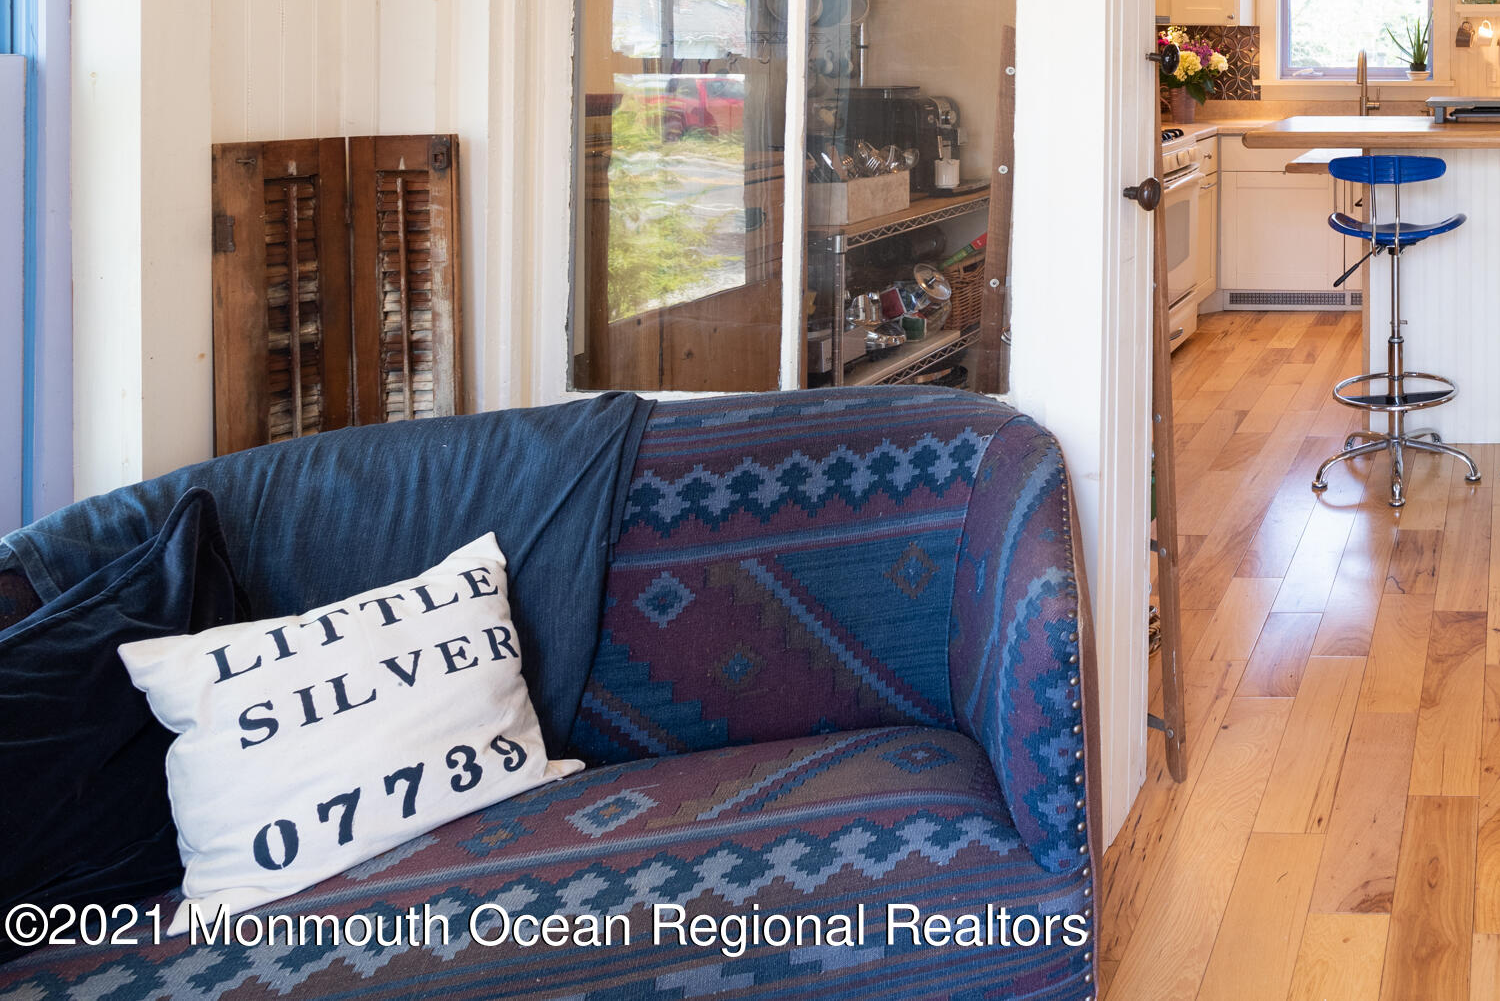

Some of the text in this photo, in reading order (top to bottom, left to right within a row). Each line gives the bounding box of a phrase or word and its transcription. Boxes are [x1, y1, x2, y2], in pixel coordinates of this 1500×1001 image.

[206, 566, 499, 684] LITTLE
[238, 626, 519, 749] SILVER
[253, 735, 527, 870] 07739
